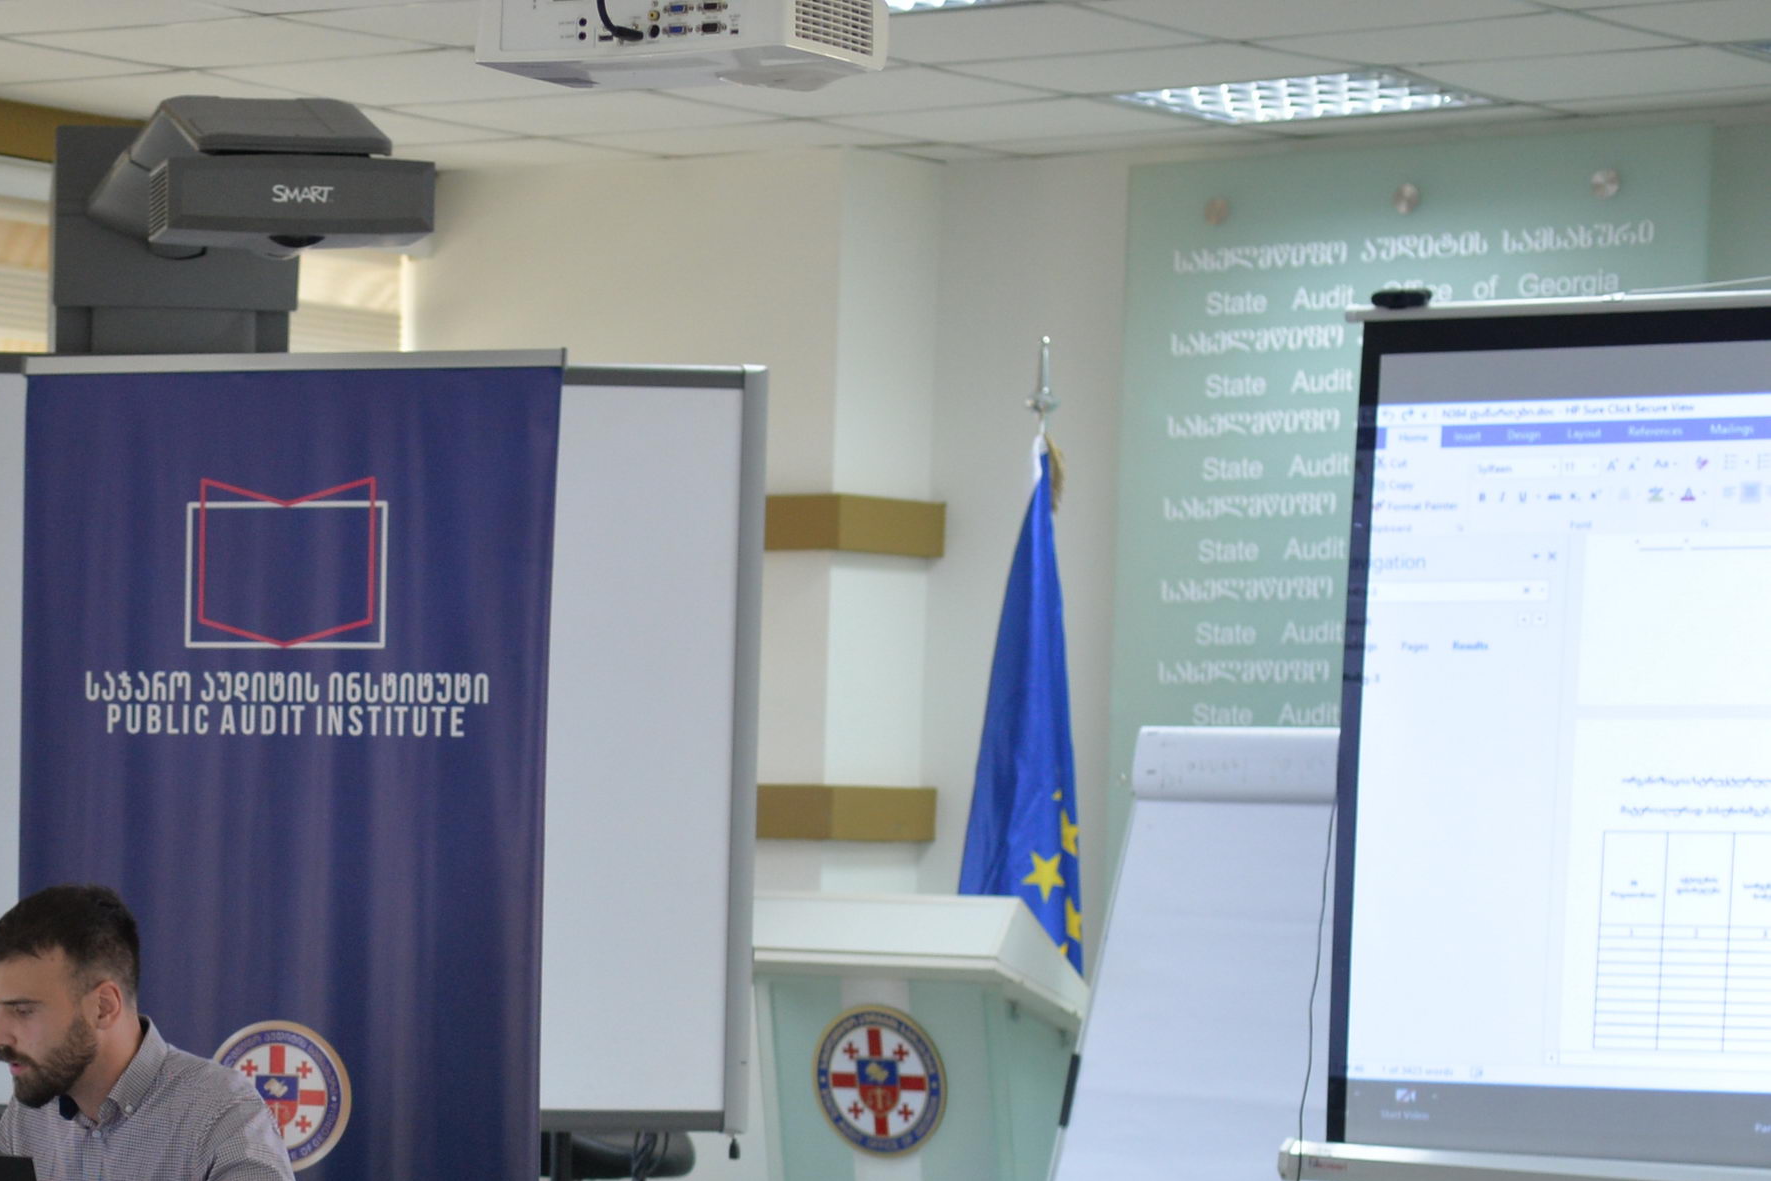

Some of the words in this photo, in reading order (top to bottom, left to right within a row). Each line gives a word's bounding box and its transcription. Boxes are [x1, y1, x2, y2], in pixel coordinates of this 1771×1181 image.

[271, 184, 335, 203] SMART
[1360, 230, 1488, 263] აუდიტის
[1205, 291, 1268, 315] State
[1291, 285, 1355, 310] Audit
[1472, 275, 1501, 299] of
[1517, 269, 1620, 298] Georgia
[1204, 374, 1267, 398] State
[1290, 370, 1354, 394] Audit
[1709, 423, 1754, 437] Mailings
[1202, 457, 1264, 481] State
[1288, 454, 1352, 478] Audit
[1197, 539, 1260, 563] State
[1283, 537, 1347, 561] Audit
[1194, 622, 1257, 646] State
[1281, 620, 1344, 645] Audit
[84, 671, 192, 701] საჯარო
[199, 671, 320, 703] აუდიტის
[328, 671, 490, 704] ინსტიტუტი
[106, 704, 210, 735] PUBLIC
[219, 704, 306, 736] AUDIT
[315, 705, 466, 738] INSTITUTE
[1192, 702, 1254, 727] State
[1277, 701, 1341, 727] Audit
